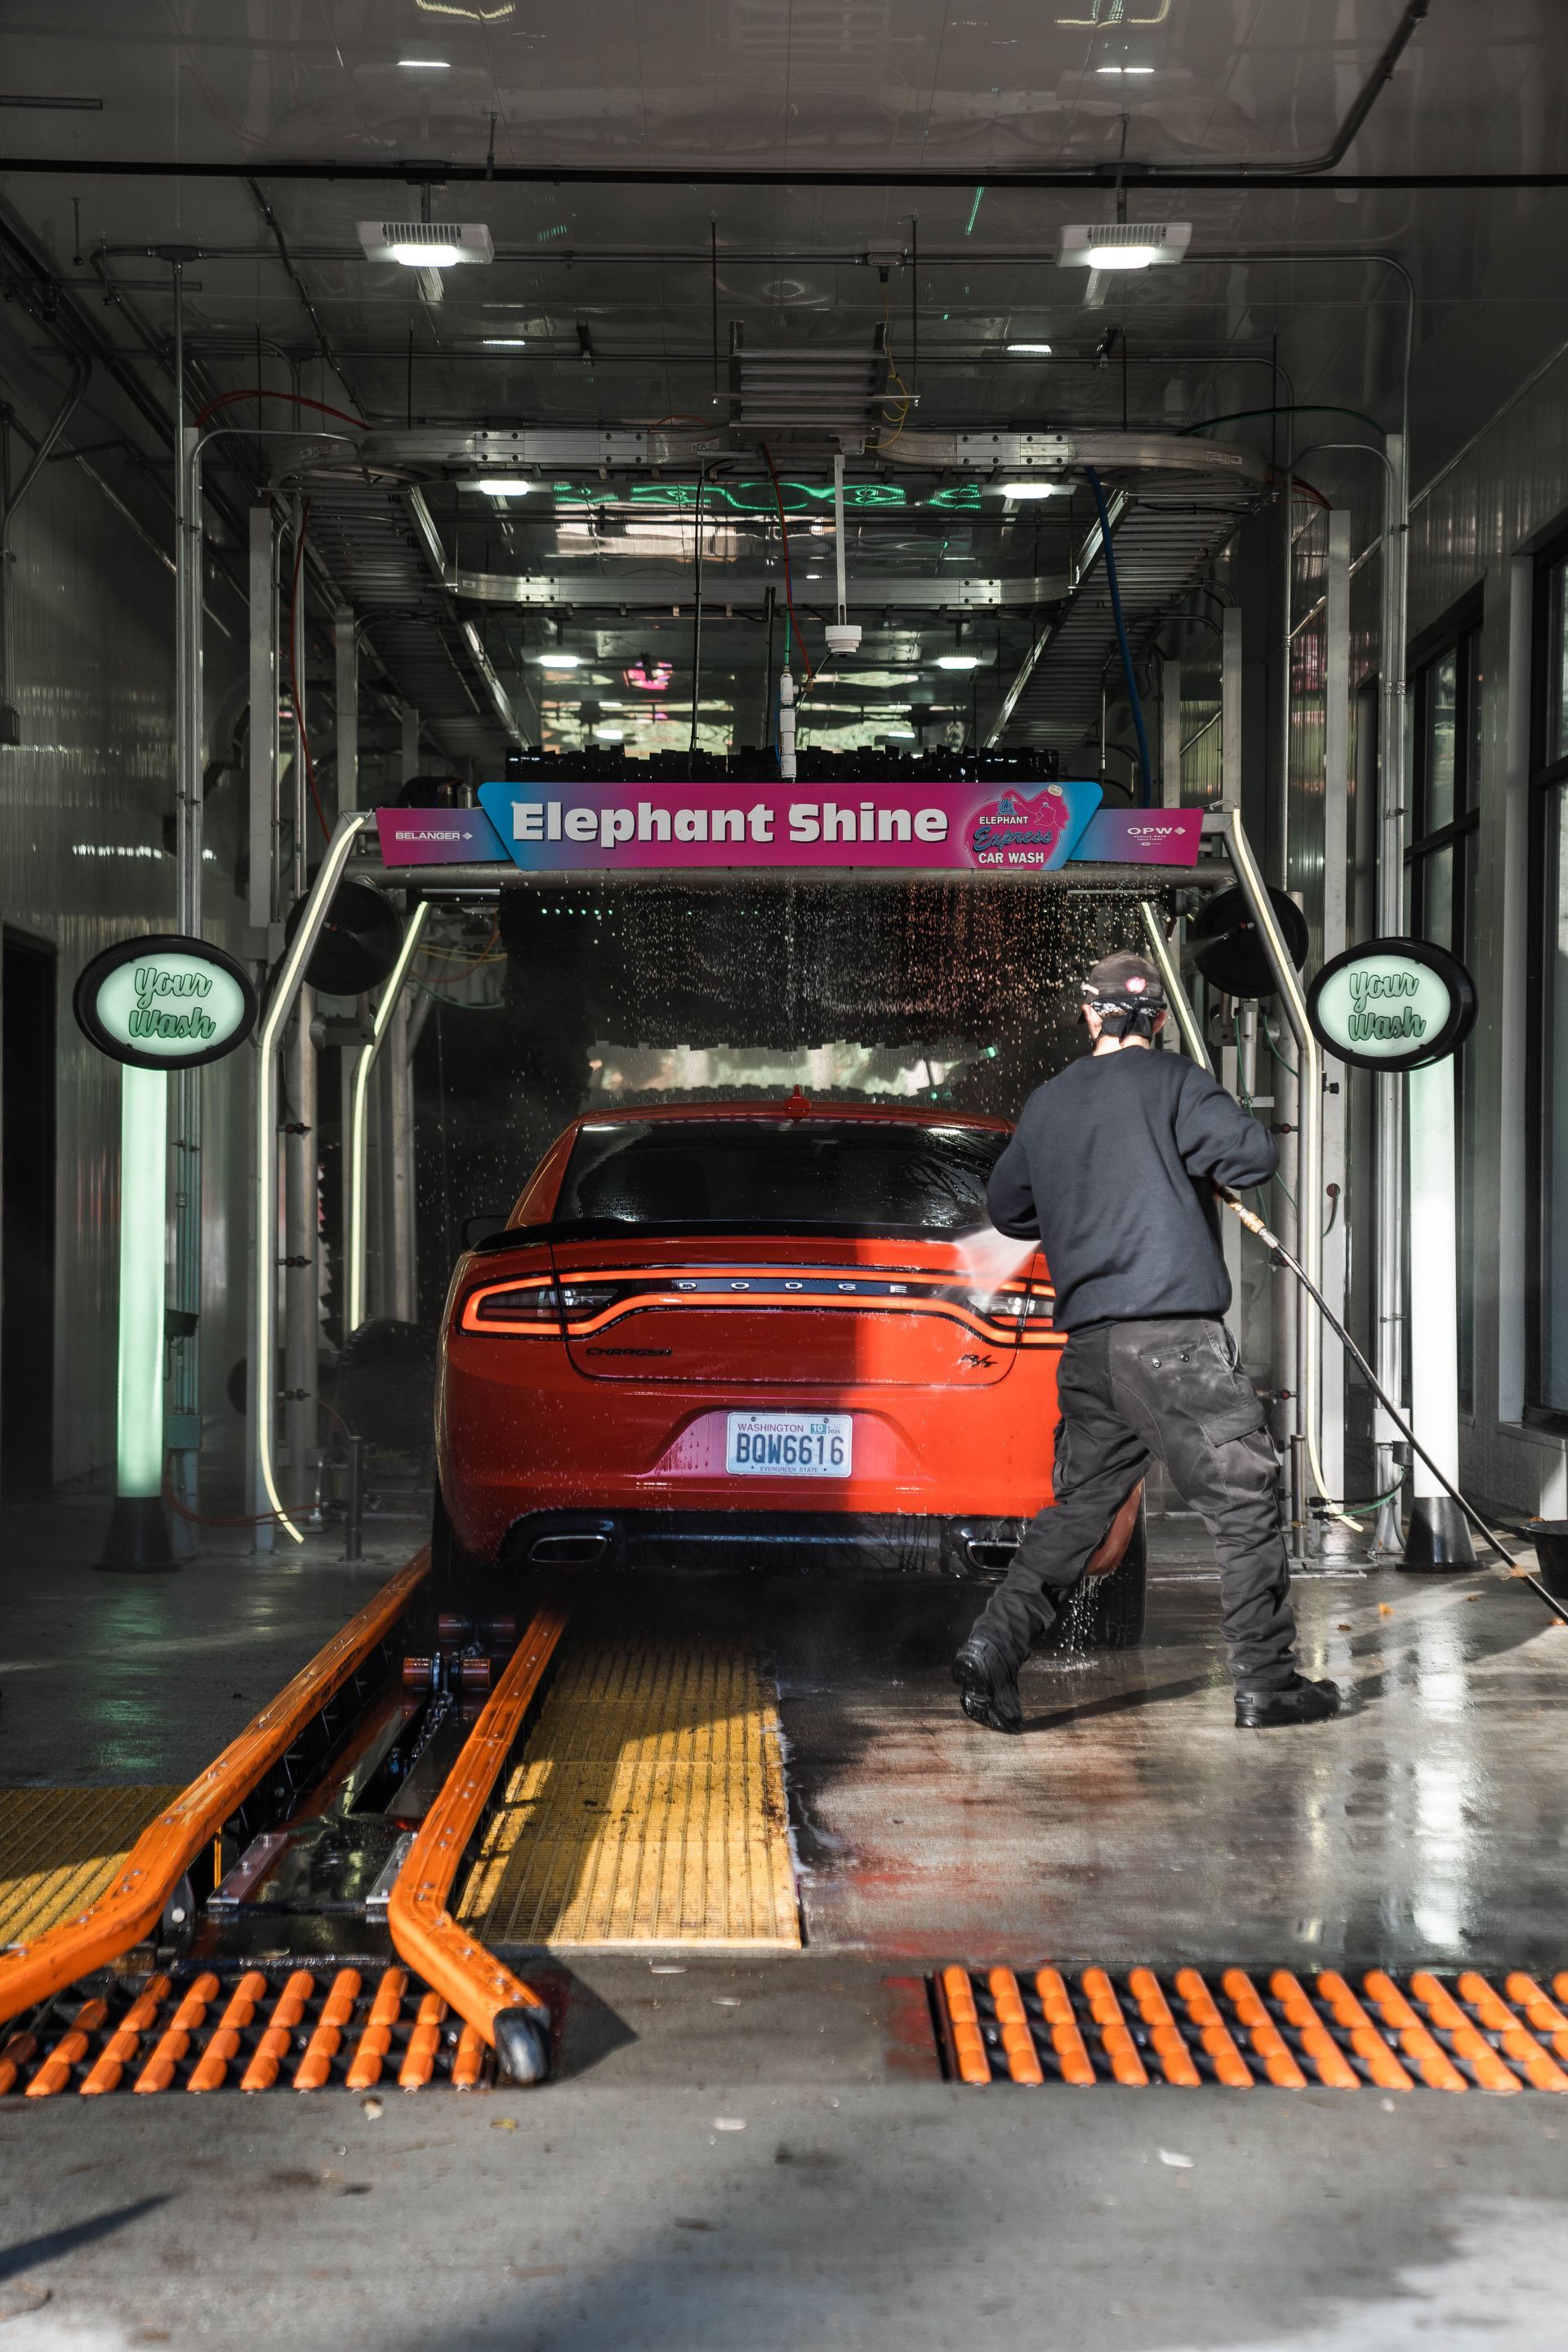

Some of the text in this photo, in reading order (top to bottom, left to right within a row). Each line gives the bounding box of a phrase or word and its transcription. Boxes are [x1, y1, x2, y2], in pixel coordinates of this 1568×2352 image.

[512, 801, 948, 848] Elephant Shine
[979, 816, 1029, 825] ELEPHANT
[395, 831, 461, 840] BELANGER
[973, 826, 1053, 852] Express
[978, 853, 1045, 863] CAR WASH
[679, 1282, 907, 1294] DODGE
[586, 1348, 673, 1356] CHARGER
[737, 1423, 804, 1432] WASHINGTON
[812, 1424, 823, 1432] 10
[737, 1433, 844, 1465] BQW6616
